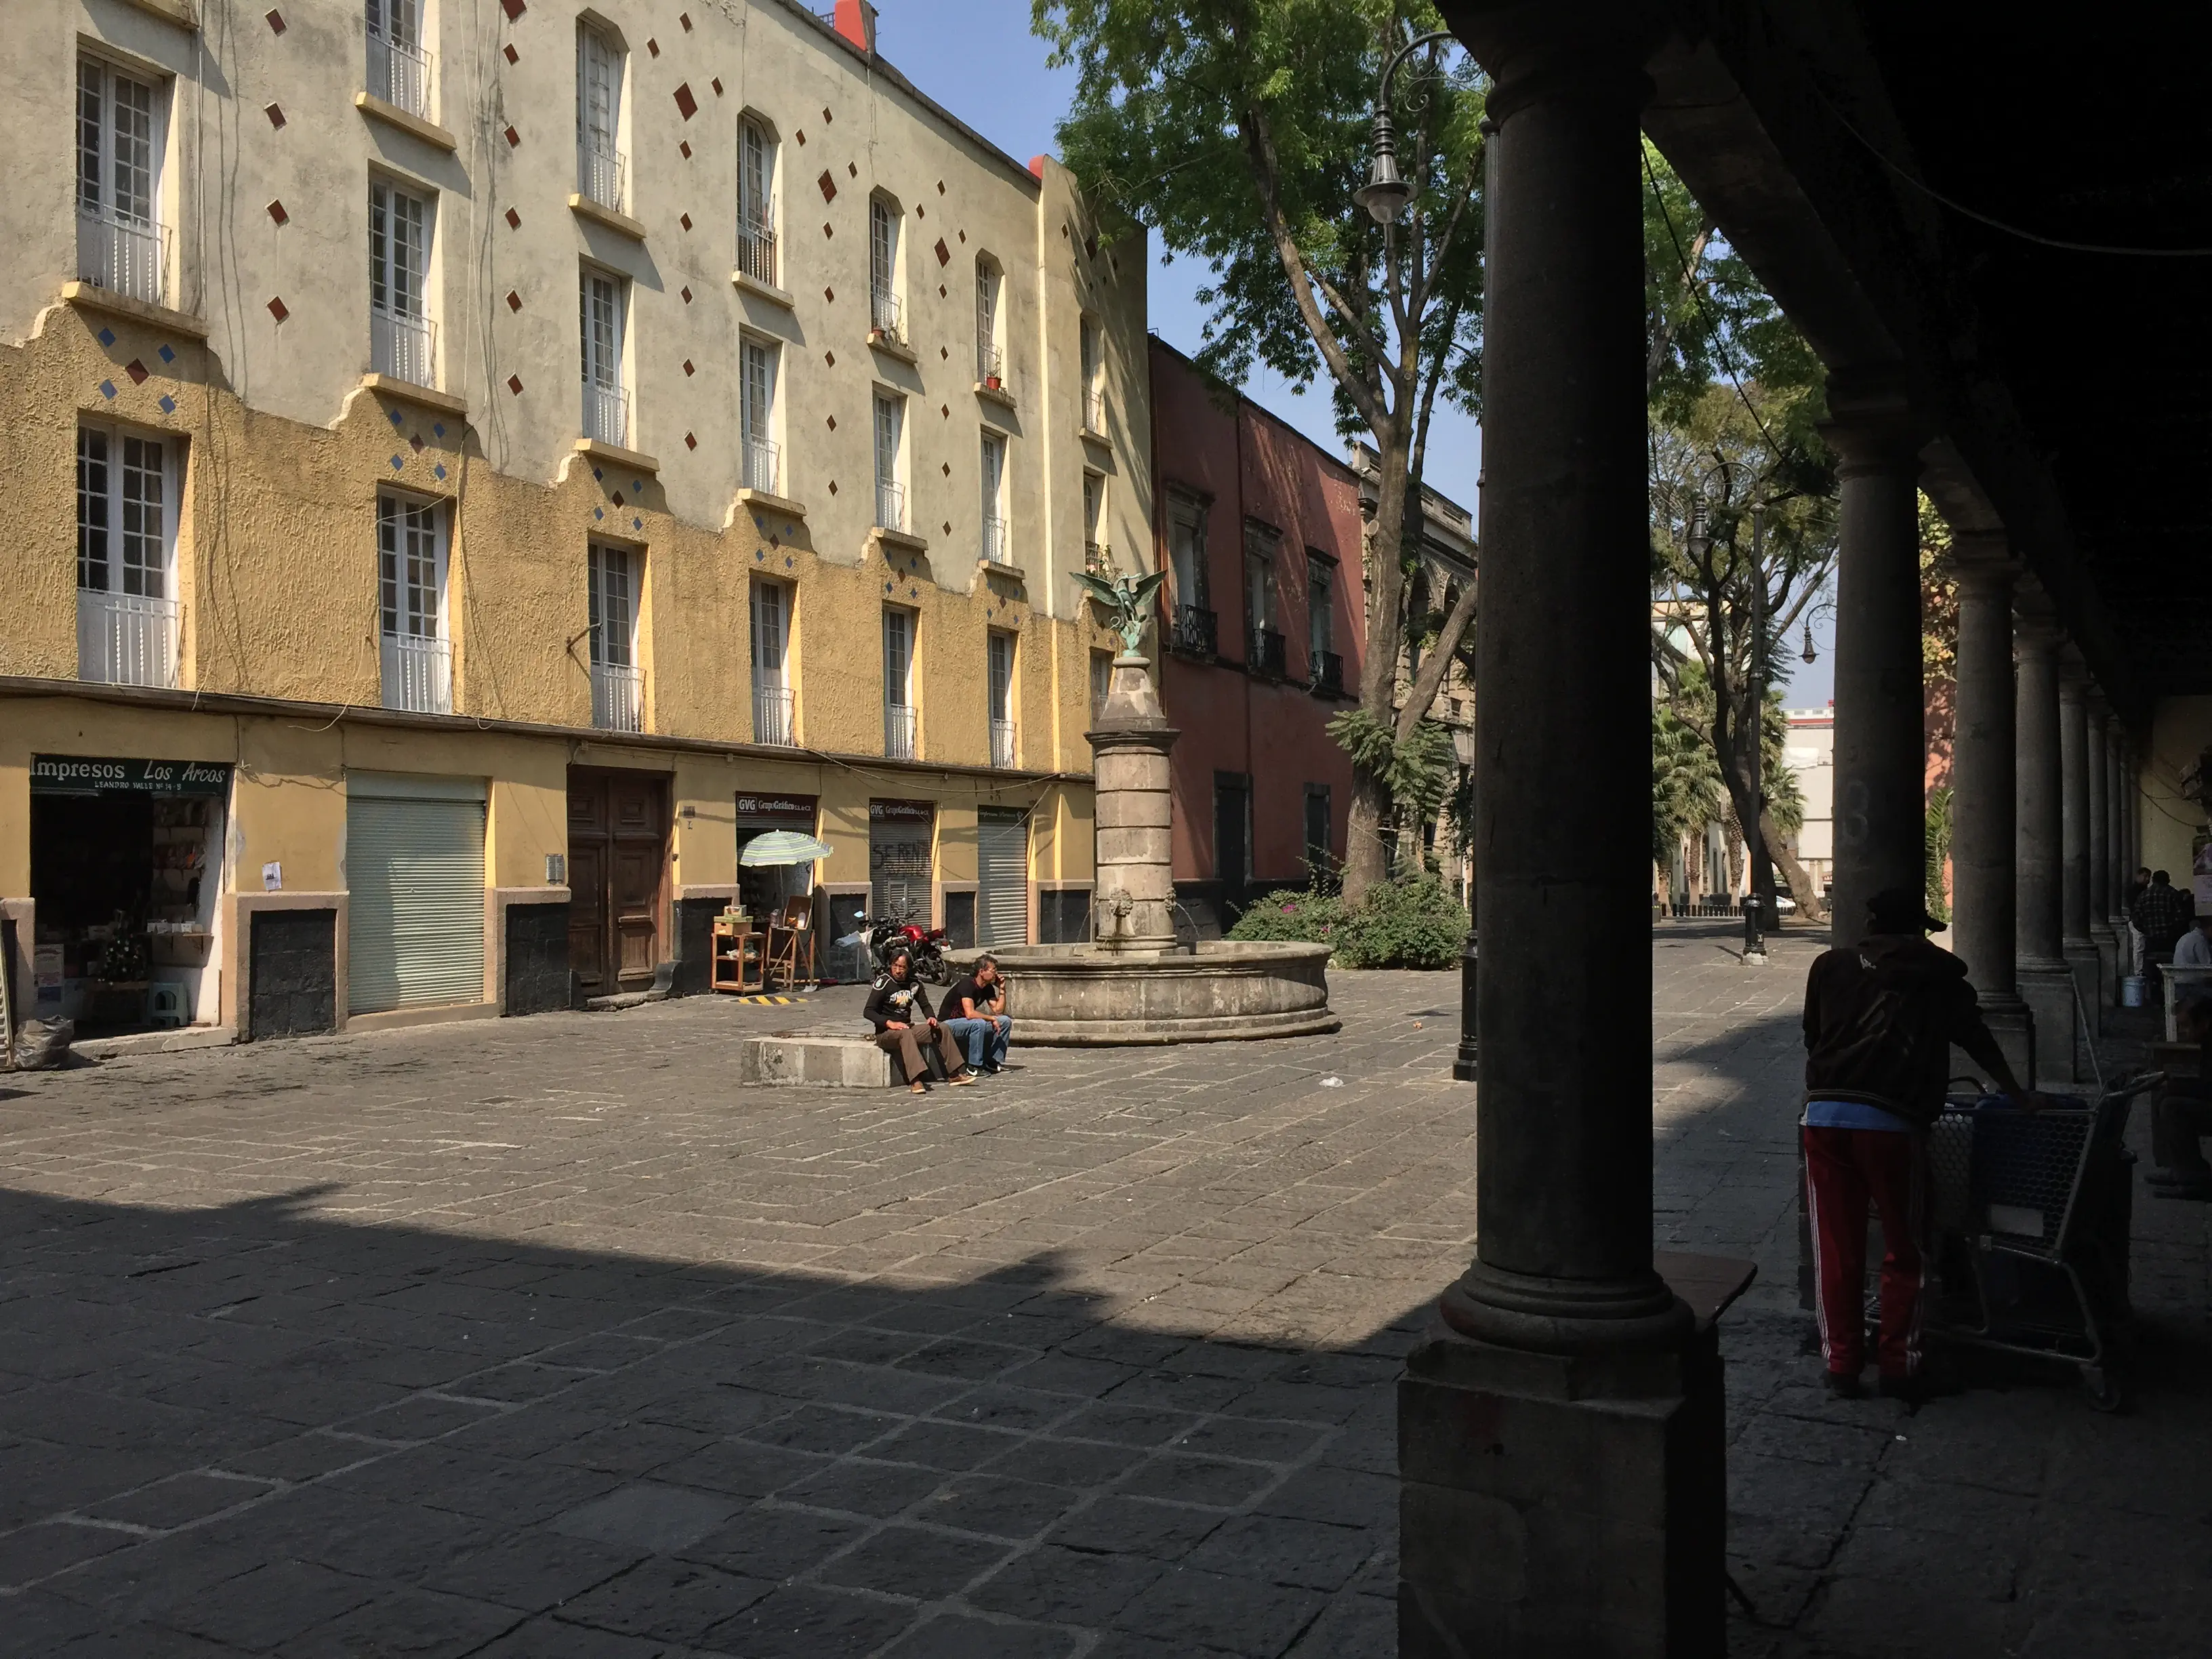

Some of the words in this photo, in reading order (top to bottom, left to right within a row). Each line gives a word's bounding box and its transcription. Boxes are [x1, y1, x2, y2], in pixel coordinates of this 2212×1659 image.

[30, 754, 125, 781] Impresos
[144, 760, 173, 781] Los
[182, 761, 226, 783] Arcos
[94, 781, 129, 789] LEANDRO
[739, 798, 756, 811] GVG
[869, 804, 884, 815] GVG
